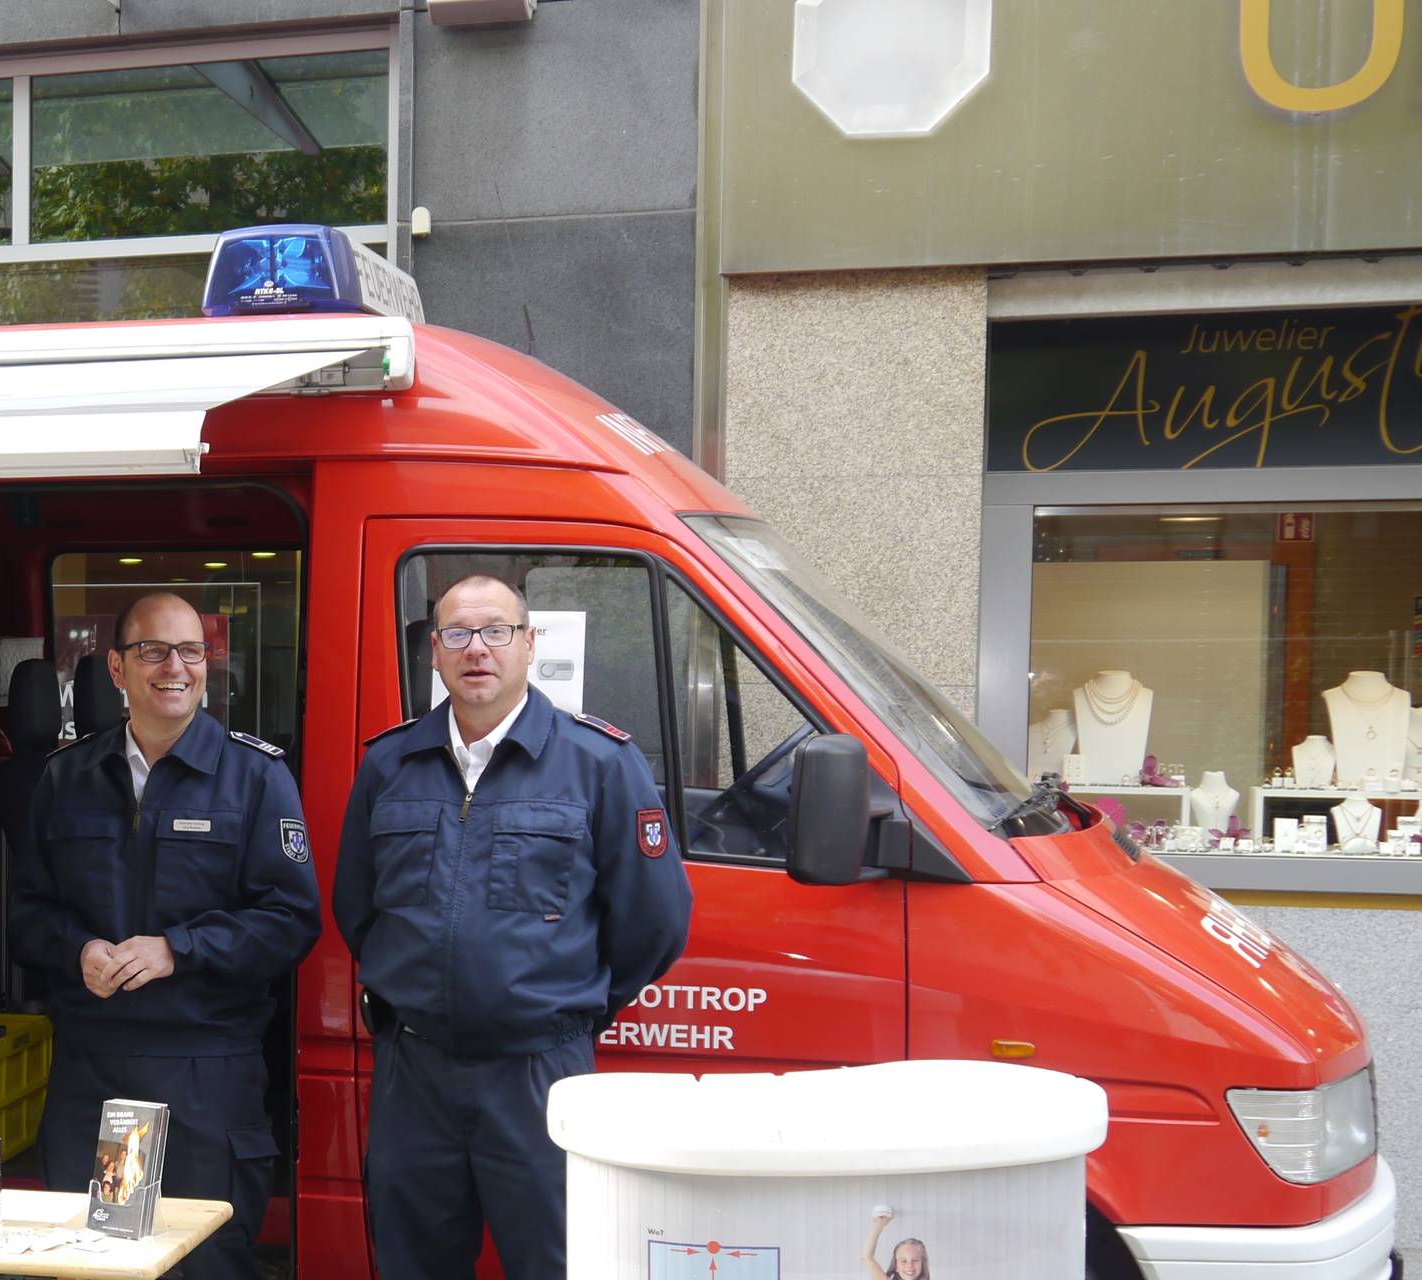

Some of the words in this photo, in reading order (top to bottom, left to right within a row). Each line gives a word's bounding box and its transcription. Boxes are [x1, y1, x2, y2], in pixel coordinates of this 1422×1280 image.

[1180, 319, 1335, 353] Juwelier
[1022, 305, 1422, 473] August
[628, 984, 767, 1012] OTTROP
[647, 1227, 664, 1236] Wo?
